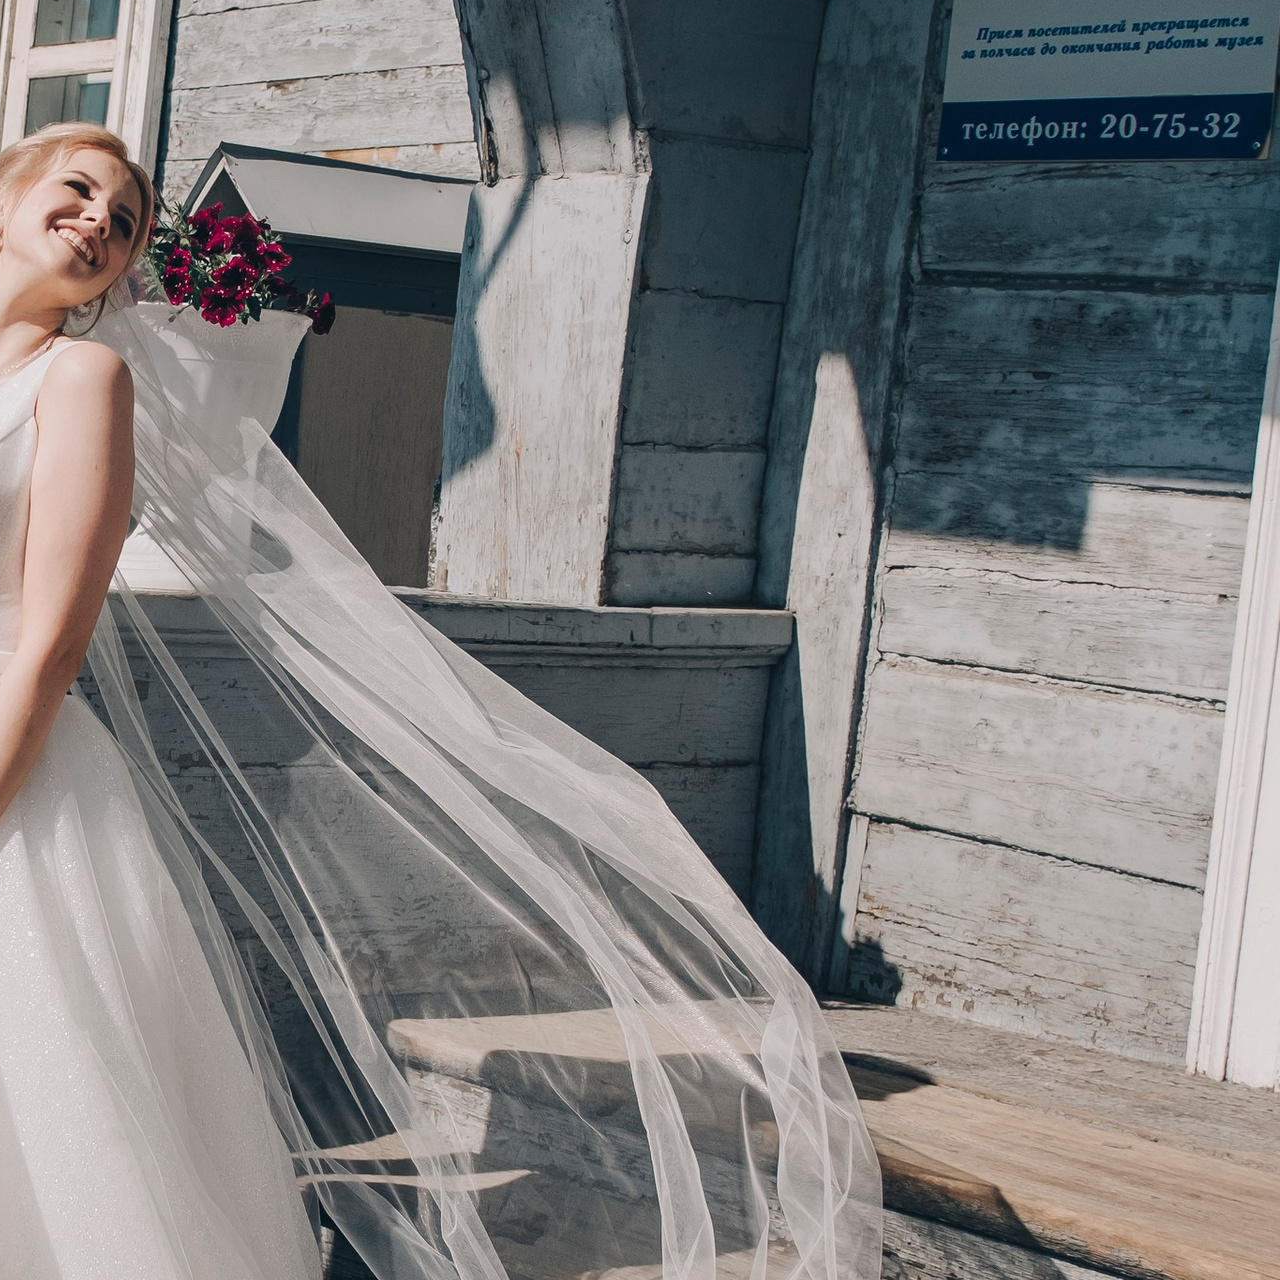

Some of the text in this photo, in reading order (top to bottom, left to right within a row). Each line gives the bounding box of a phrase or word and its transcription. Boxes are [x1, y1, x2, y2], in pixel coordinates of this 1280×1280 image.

[976, 16, 1250, 43] Прием посетителей прекращается
[961, 34, 1265, 60] за полчаса до окончания работы музея
[962, 113, 1241, 146] телефон: 20-75-32
